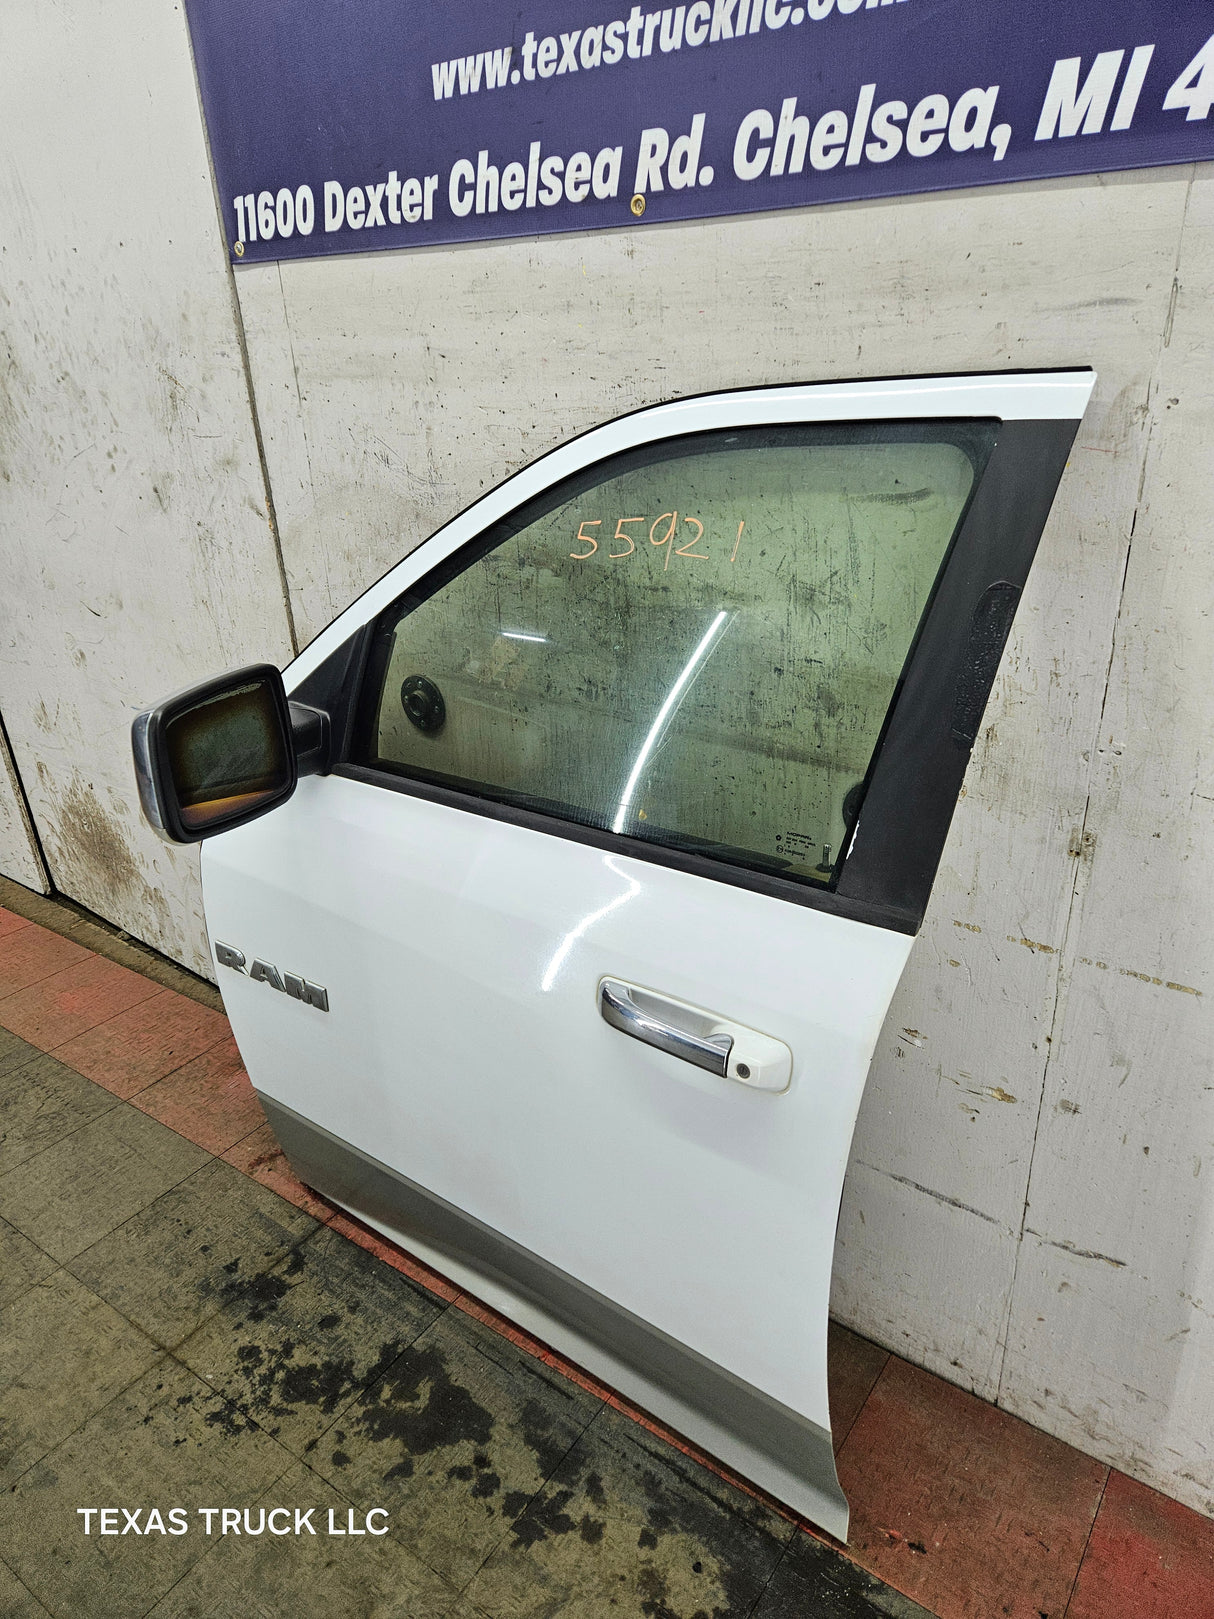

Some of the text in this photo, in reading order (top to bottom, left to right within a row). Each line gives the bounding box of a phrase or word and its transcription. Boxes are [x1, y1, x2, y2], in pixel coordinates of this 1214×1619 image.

[233, 184, 315, 243] 11600
[324, 170, 439, 233] Dexter
[448, 141, 623, 217] Chelsea
[634, 112, 715, 194] Rd.
[733, 83, 1012, 182] Chelsea,
[1034, 43, 1156, 141] MI
[569, 510, 745, 572] 55921
[214, 939, 330, 1013] RAM
